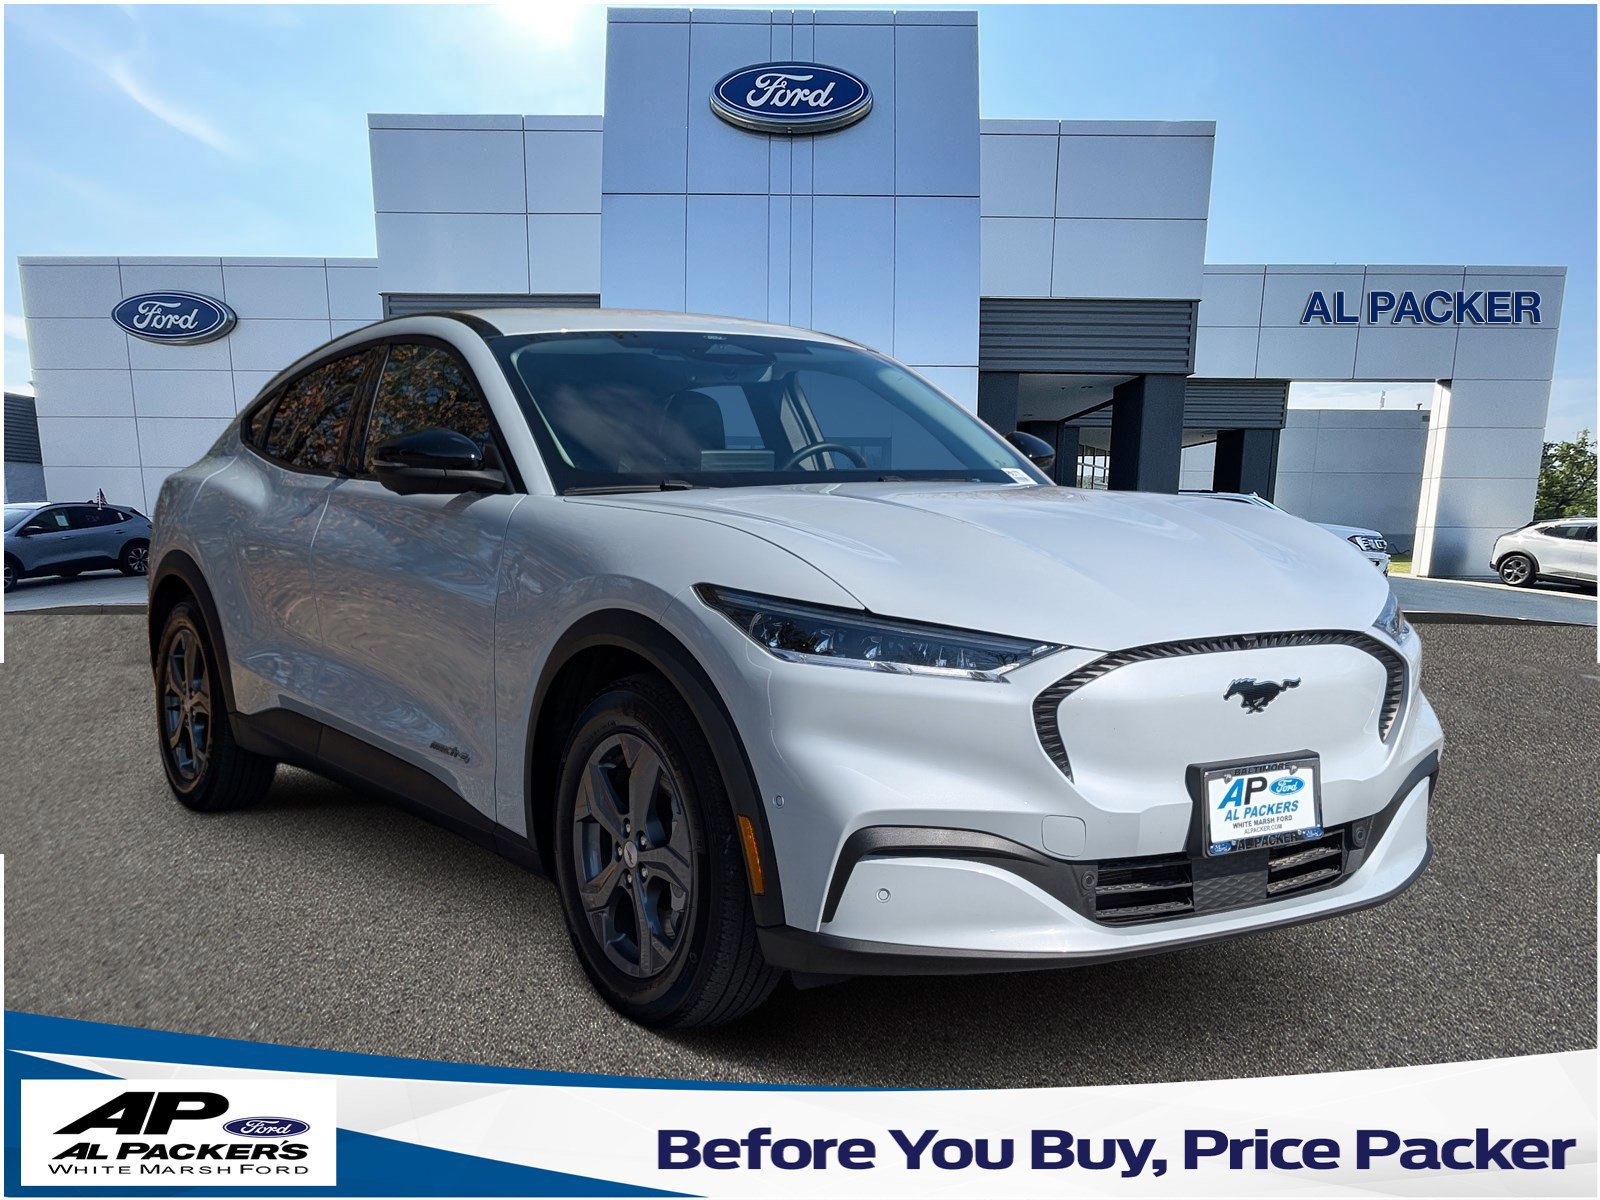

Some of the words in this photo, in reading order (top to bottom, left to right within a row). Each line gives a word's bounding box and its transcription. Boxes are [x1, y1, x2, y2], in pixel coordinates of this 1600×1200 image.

[746, 73, 836, 108] Ford
[133, 301, 198, 329] Ford
[1301, 290, 1359, 324] AL
[1368, 290, 1542, 325] PACKER
[1218, 776, 1267, 809] AP
[1275, 779, 1298, 793] Ford
[1224, 810, 1240, 822] AL
[1243, 800, 1299, 819] PACKERS
[1233, 820, 1252, 829] WHITE
[1254, 817, 1275, 827] MARSH
[1276, 815, 1293, 823] FORD
